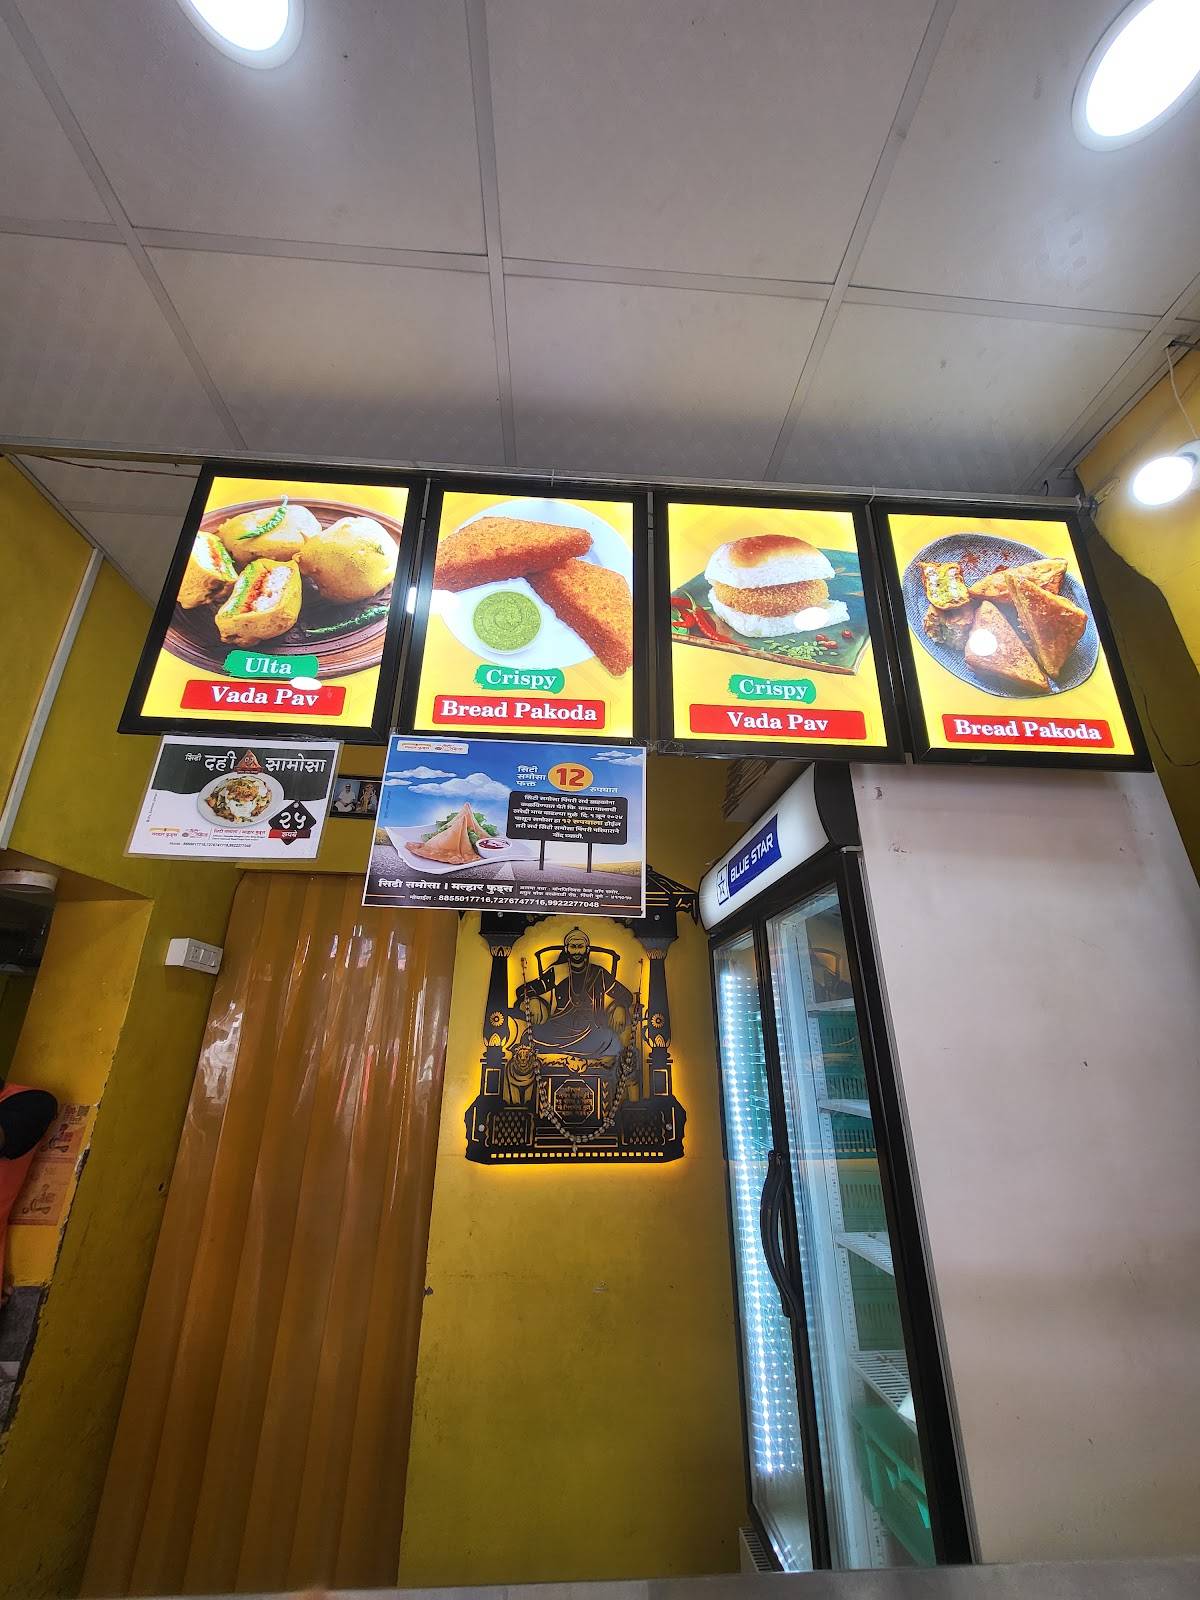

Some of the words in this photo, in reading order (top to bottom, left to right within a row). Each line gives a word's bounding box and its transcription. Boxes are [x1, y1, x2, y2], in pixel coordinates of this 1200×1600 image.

[245, 657, 292, 674] Ulta
[486, 669, 558, 690] Crispy
[739, 679, 809, 700] Crispy
[211, 685, 268, 704] Vada
[274, 688, 319, 707] Pav
[440, 699, 508, 718] Bread
[513, 702, 597, 721] Pakoda
[727, 711, 783, 730] Vada
[786, 714, 829, 732] Pav
[953, 719, 1020, 737] Bread
[1022, 721, 1102, 740] Pakoda
[204, 750, 237, 771] दही
[265, 753, 327, 773] सामोसा
[517, 765, 539, 773] सिटी
[556, 768, 585, 786] 12
[730, 854, 750, 883] BLUE
[751, 832, 774, 865] STAR
[378, 878, 403, 888] सिटी
[405, 880, 441, 890] समोसा
[451, 882, 485, 893] मल्हार
